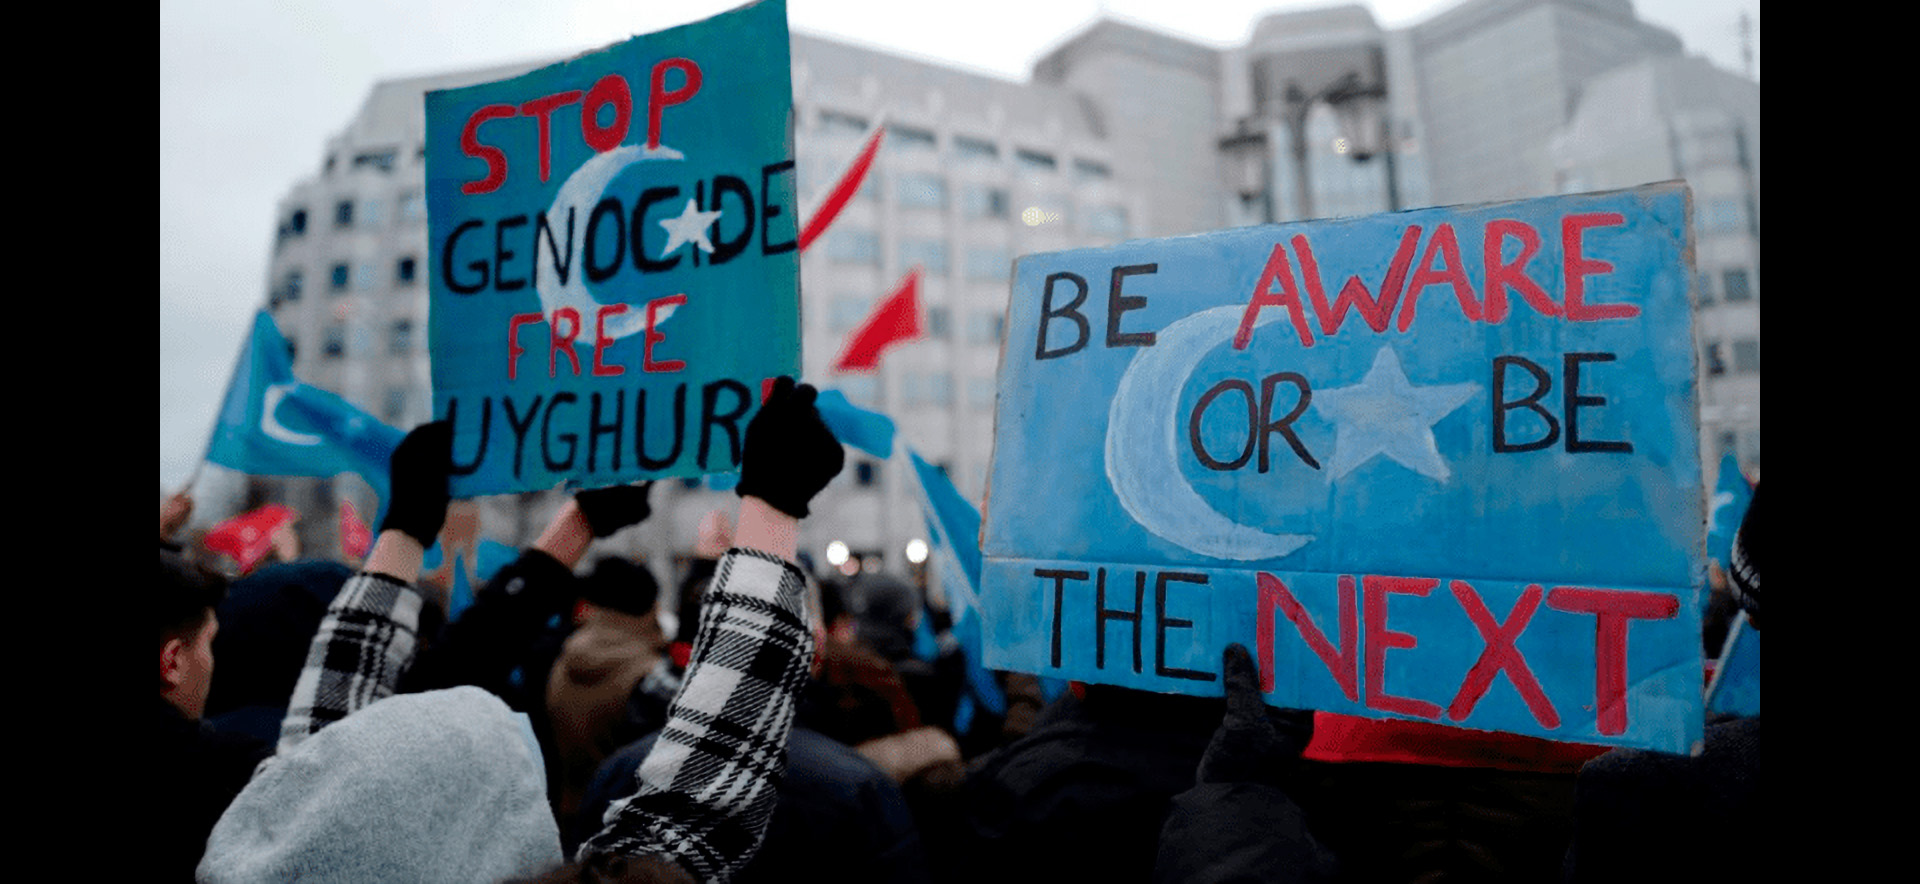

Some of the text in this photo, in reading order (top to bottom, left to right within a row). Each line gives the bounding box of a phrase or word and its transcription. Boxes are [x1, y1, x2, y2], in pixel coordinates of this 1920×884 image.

[460, 57, 702, 196] STOP
[442, 160, 798, 295] GENOCIDE
[1035, 213, 1641, 360] BE AWARE
[509, 294, 688, 380] FREE
[1189, 352, 1634, 473] OR BE
[1034, 568, 1680, 736] THE NEXT
